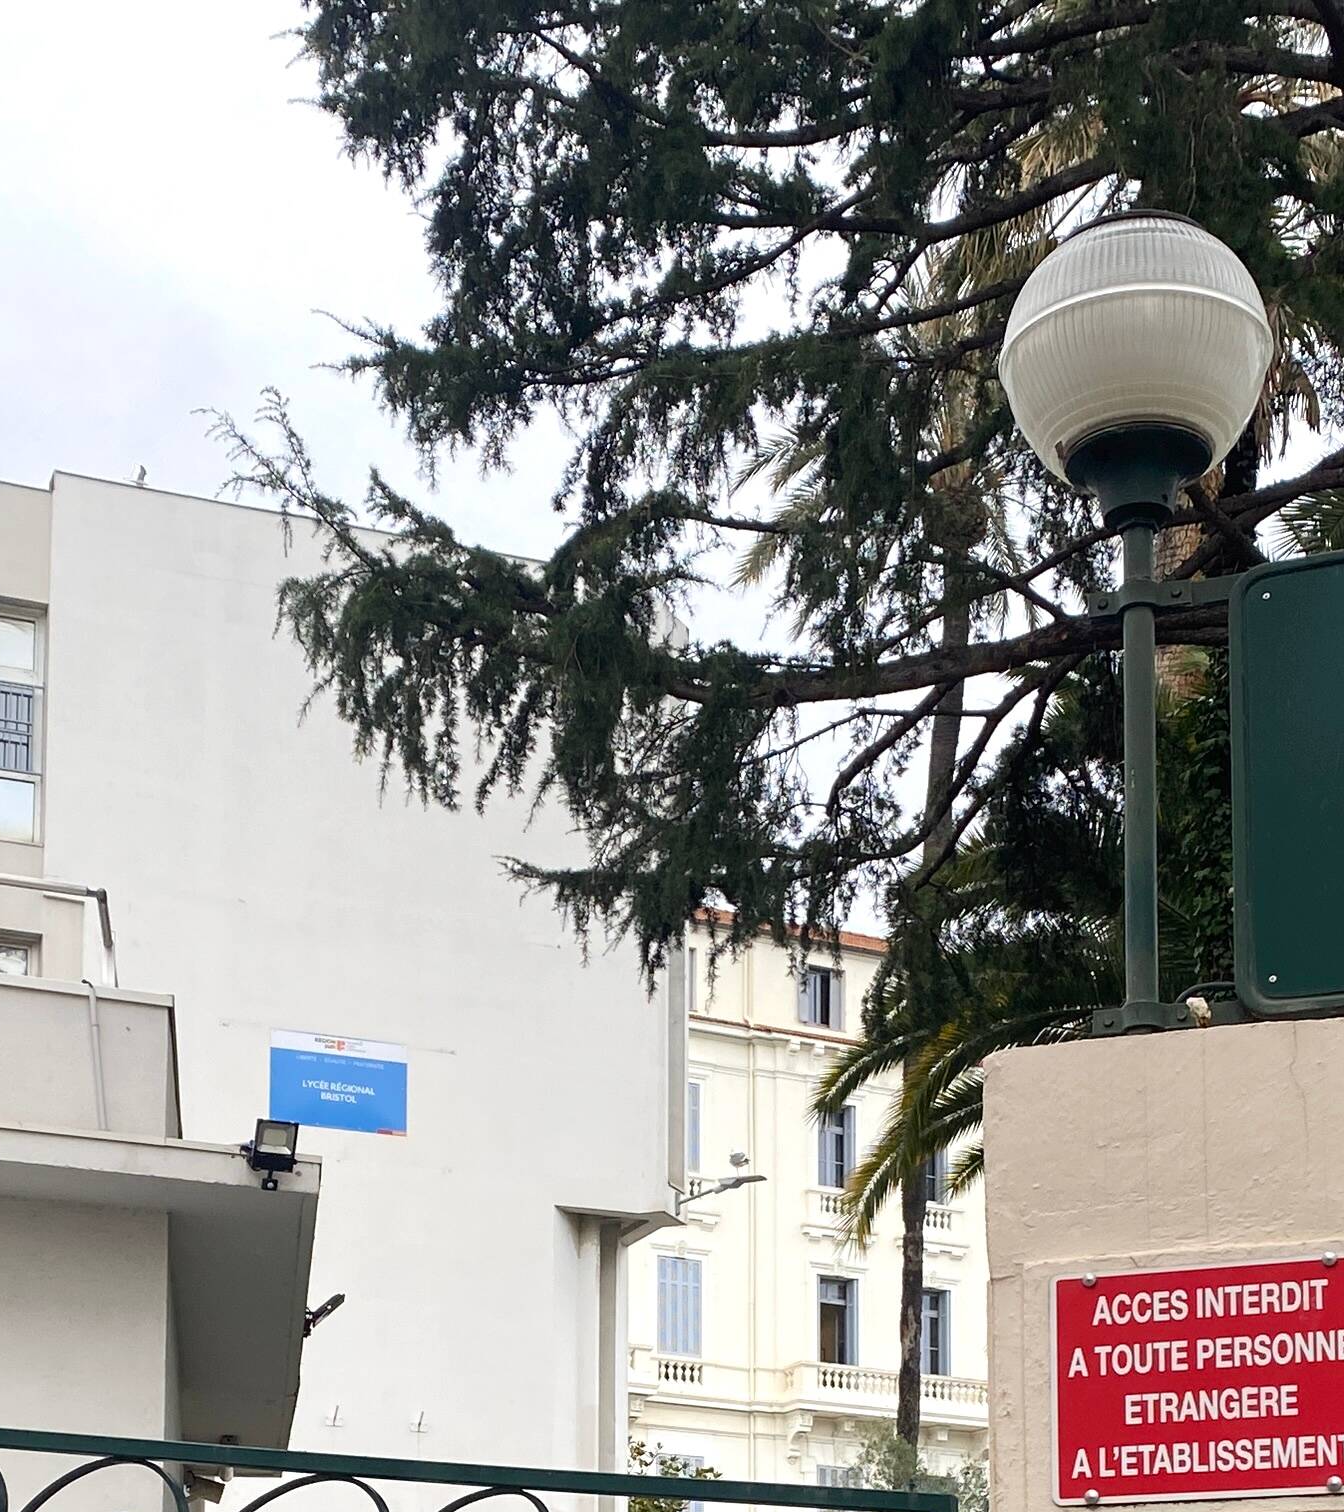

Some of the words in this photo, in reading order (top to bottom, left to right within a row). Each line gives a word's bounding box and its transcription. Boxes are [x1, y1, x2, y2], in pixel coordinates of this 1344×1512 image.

[302, 1079, 330, 1091] LYCÉE
[330, 1081, 375, 1096] RÉGIONAL
[320, 1091, 357, 1104] BRISTOL
[1092, 1288, 1188, 1326] ACCES
[1196, 1278, 1329, 1318] INTERDIT
[1068, 1347, 1089, 1378] A
[1094, 1340, 1188, 1376] TOUTE
[1124, 1384, 1299, 1425] ETRANGERE
[1072, 1448, 1092, 1479] A
